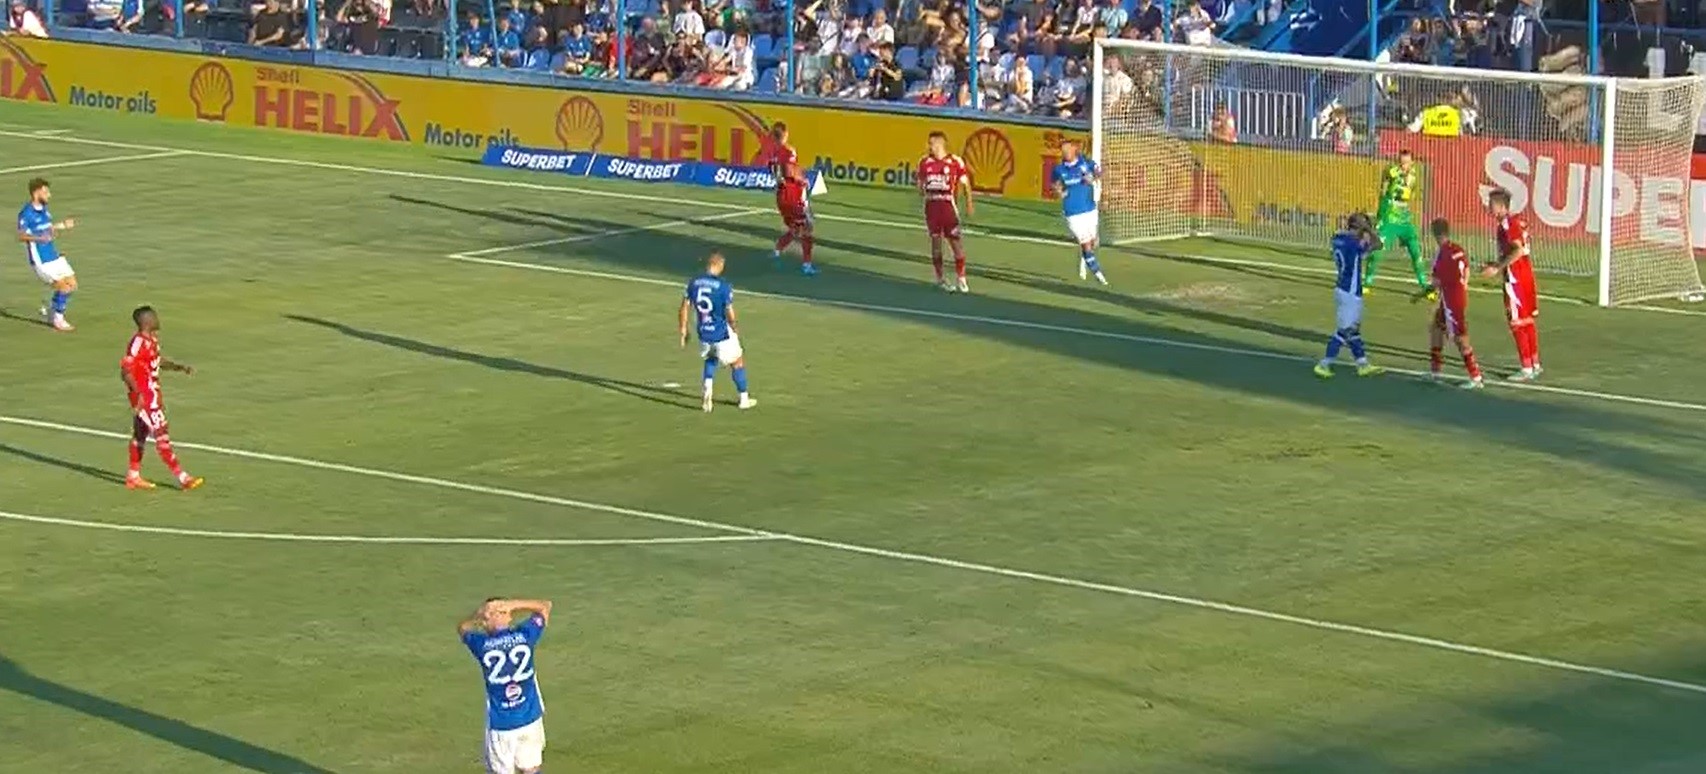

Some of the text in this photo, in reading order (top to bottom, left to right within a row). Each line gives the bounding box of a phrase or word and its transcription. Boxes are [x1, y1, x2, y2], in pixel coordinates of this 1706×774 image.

[256, 67, 300, 84] Shell
[69, 86, 156, 114] Motor oils
[627, 99, 676, 117] Shell
[254, 86, 405, 141] HELIX
[425, 122, 483, 148] Motor
[501, 149, 576, 170] SUPERBET
[608, 158, 681, 179] SUPERBET
[816, 156, 879, 182] Motor
[714, 167, 776, 188] SUPERB
[696, 286, 713, 313] 5
[483, 644, 534, 684] 22
